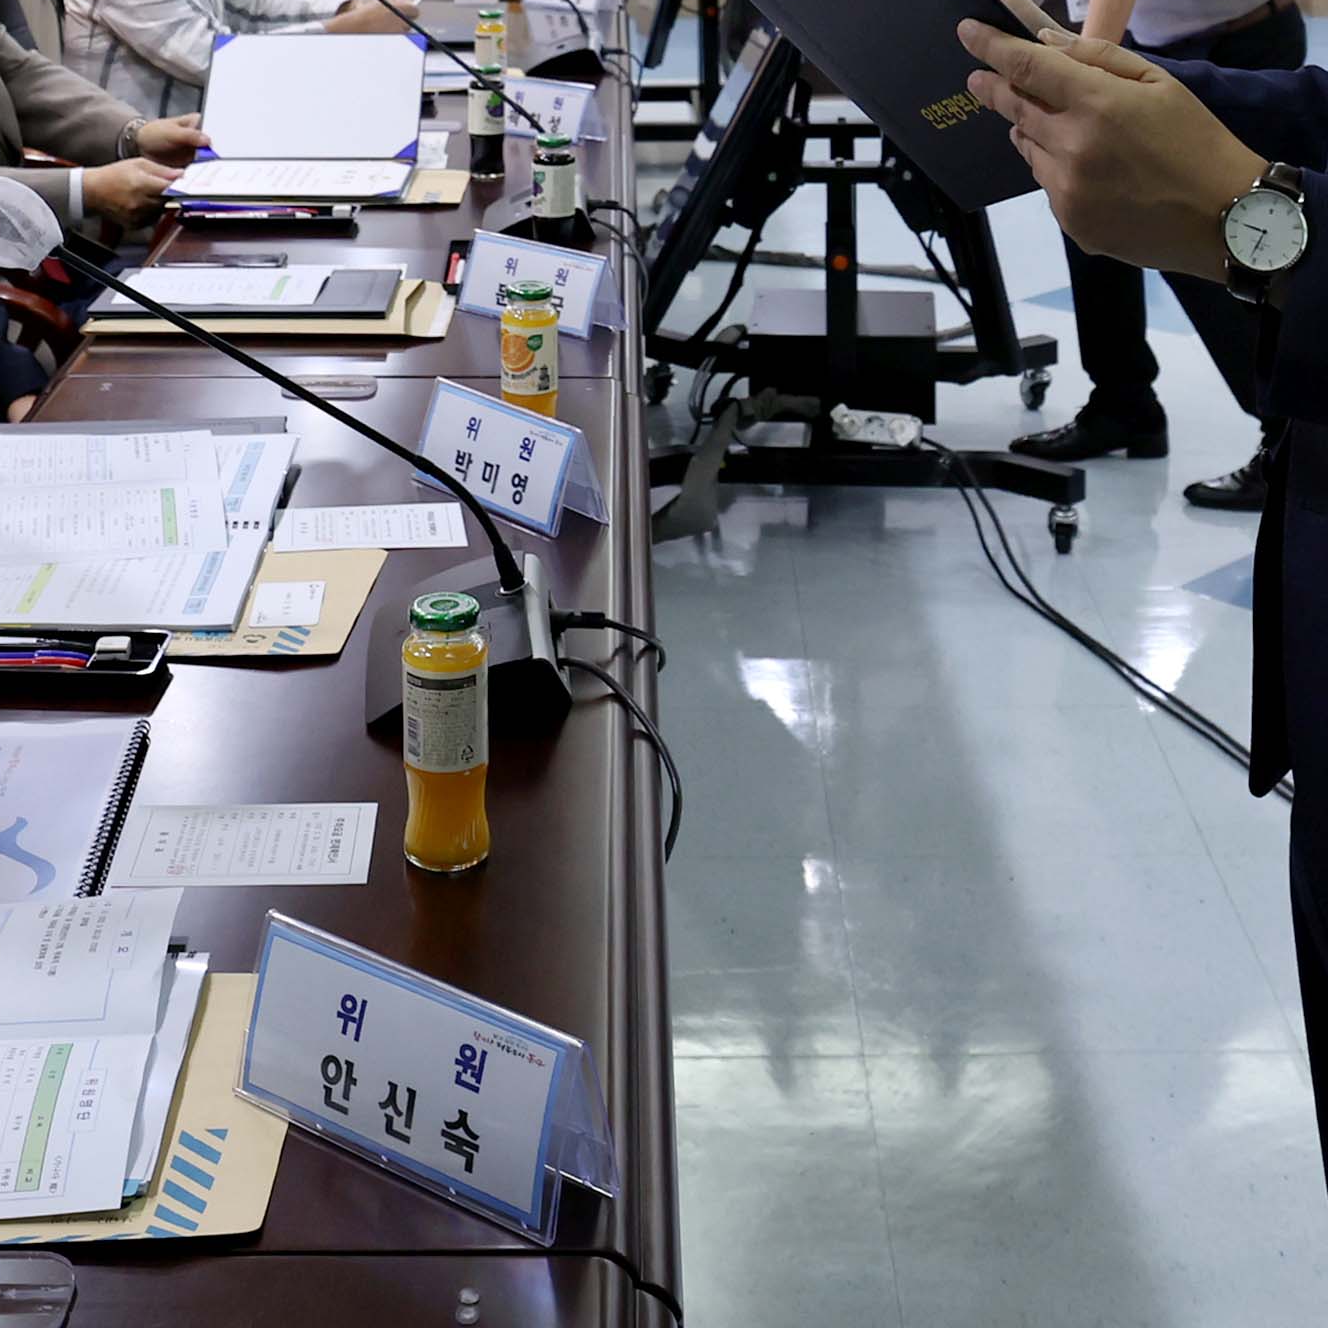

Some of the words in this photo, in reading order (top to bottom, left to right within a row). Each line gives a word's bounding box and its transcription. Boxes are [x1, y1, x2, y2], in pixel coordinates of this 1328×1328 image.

[504, 257, 519, 277] 위
[555, 268, 570, 287] 원
[466, 416, 482, 442] 위
[519, 437, 537, 463] 원
[455, 449, 529, 506] 박미영
[335, 993, 368, 1043] 위
[453, 1043, 488, 1094] 원
[319, 1053, 481, 1174] 안신숙
